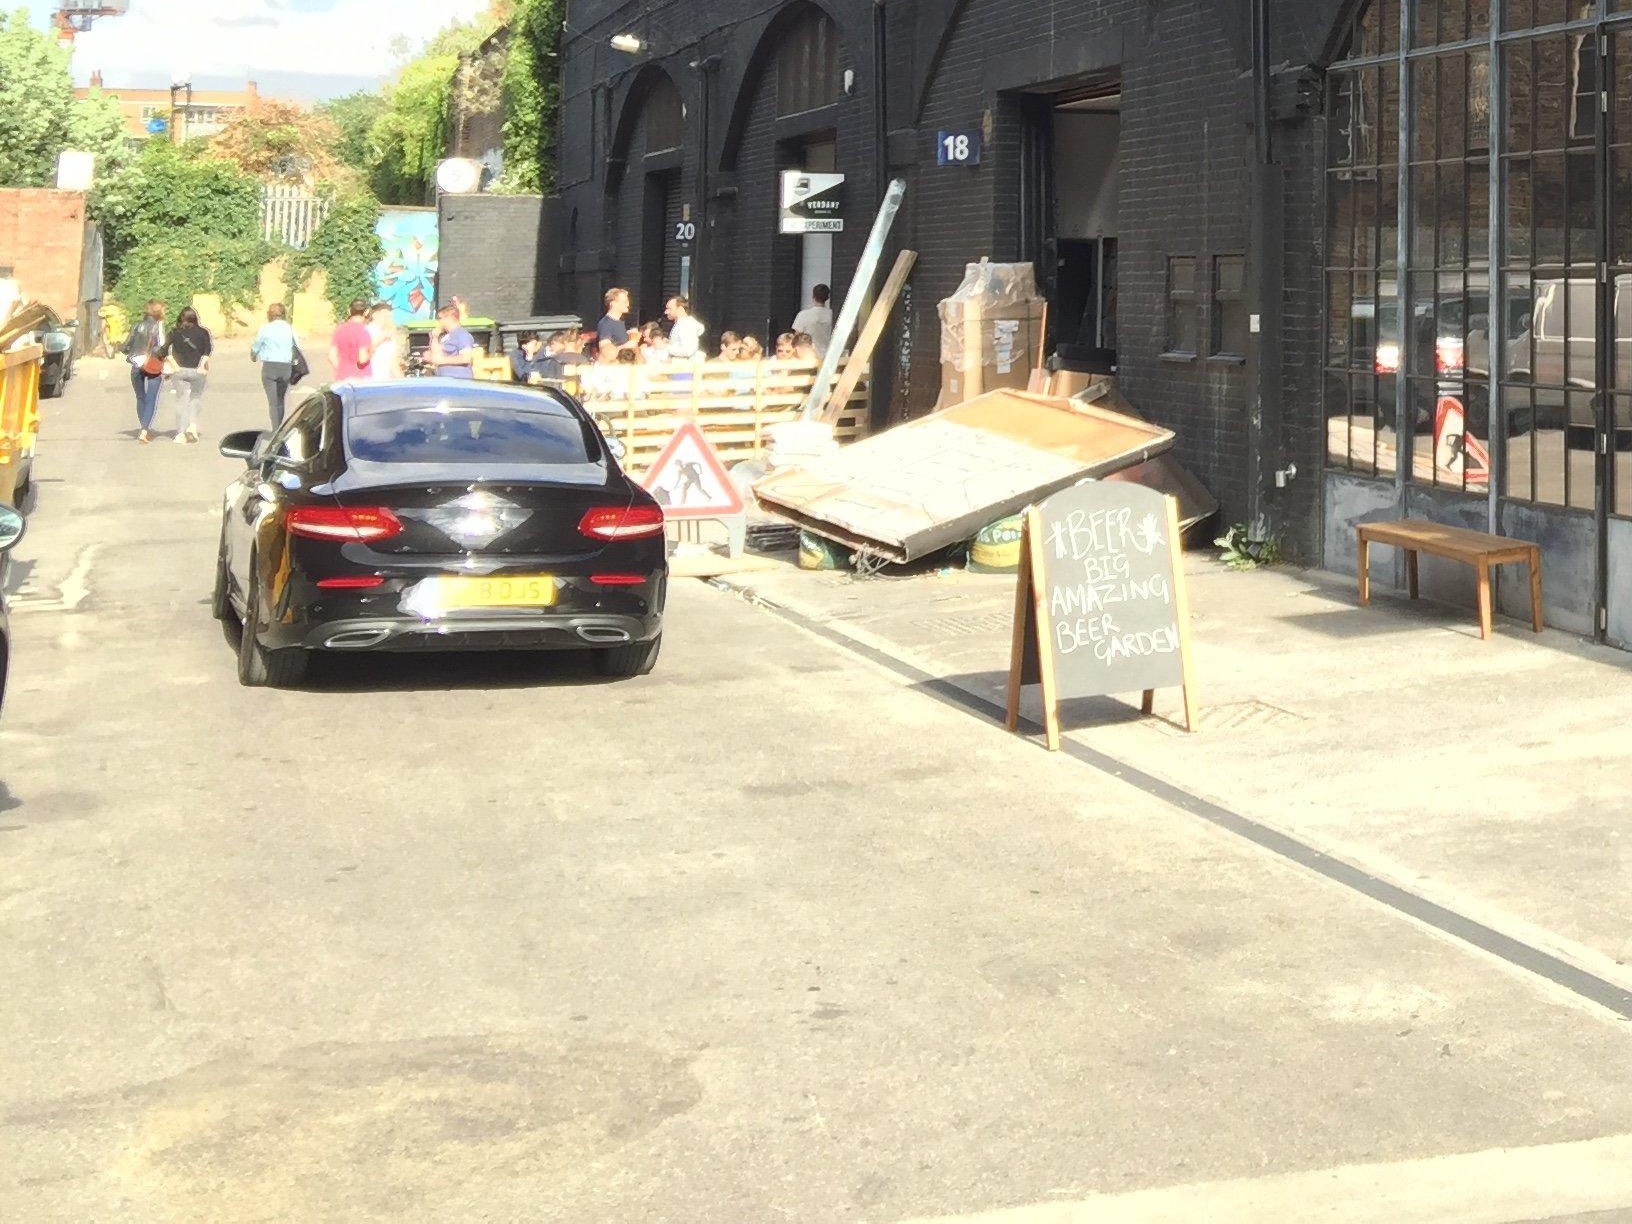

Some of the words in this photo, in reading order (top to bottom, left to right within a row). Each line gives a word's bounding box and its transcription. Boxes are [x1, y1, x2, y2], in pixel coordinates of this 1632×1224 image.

[942, 134, 969, 161] 18
[675, 222, 695, 240] 20
[1066, 507, 1140, 560] BEER
[1083, 554, 1130, 584] BIG
[1051, 573, 1170, 617] AMAZING
[1056, 613, 1121, 655] BEER
[1094, 622, 1180, 666] GARDEN
